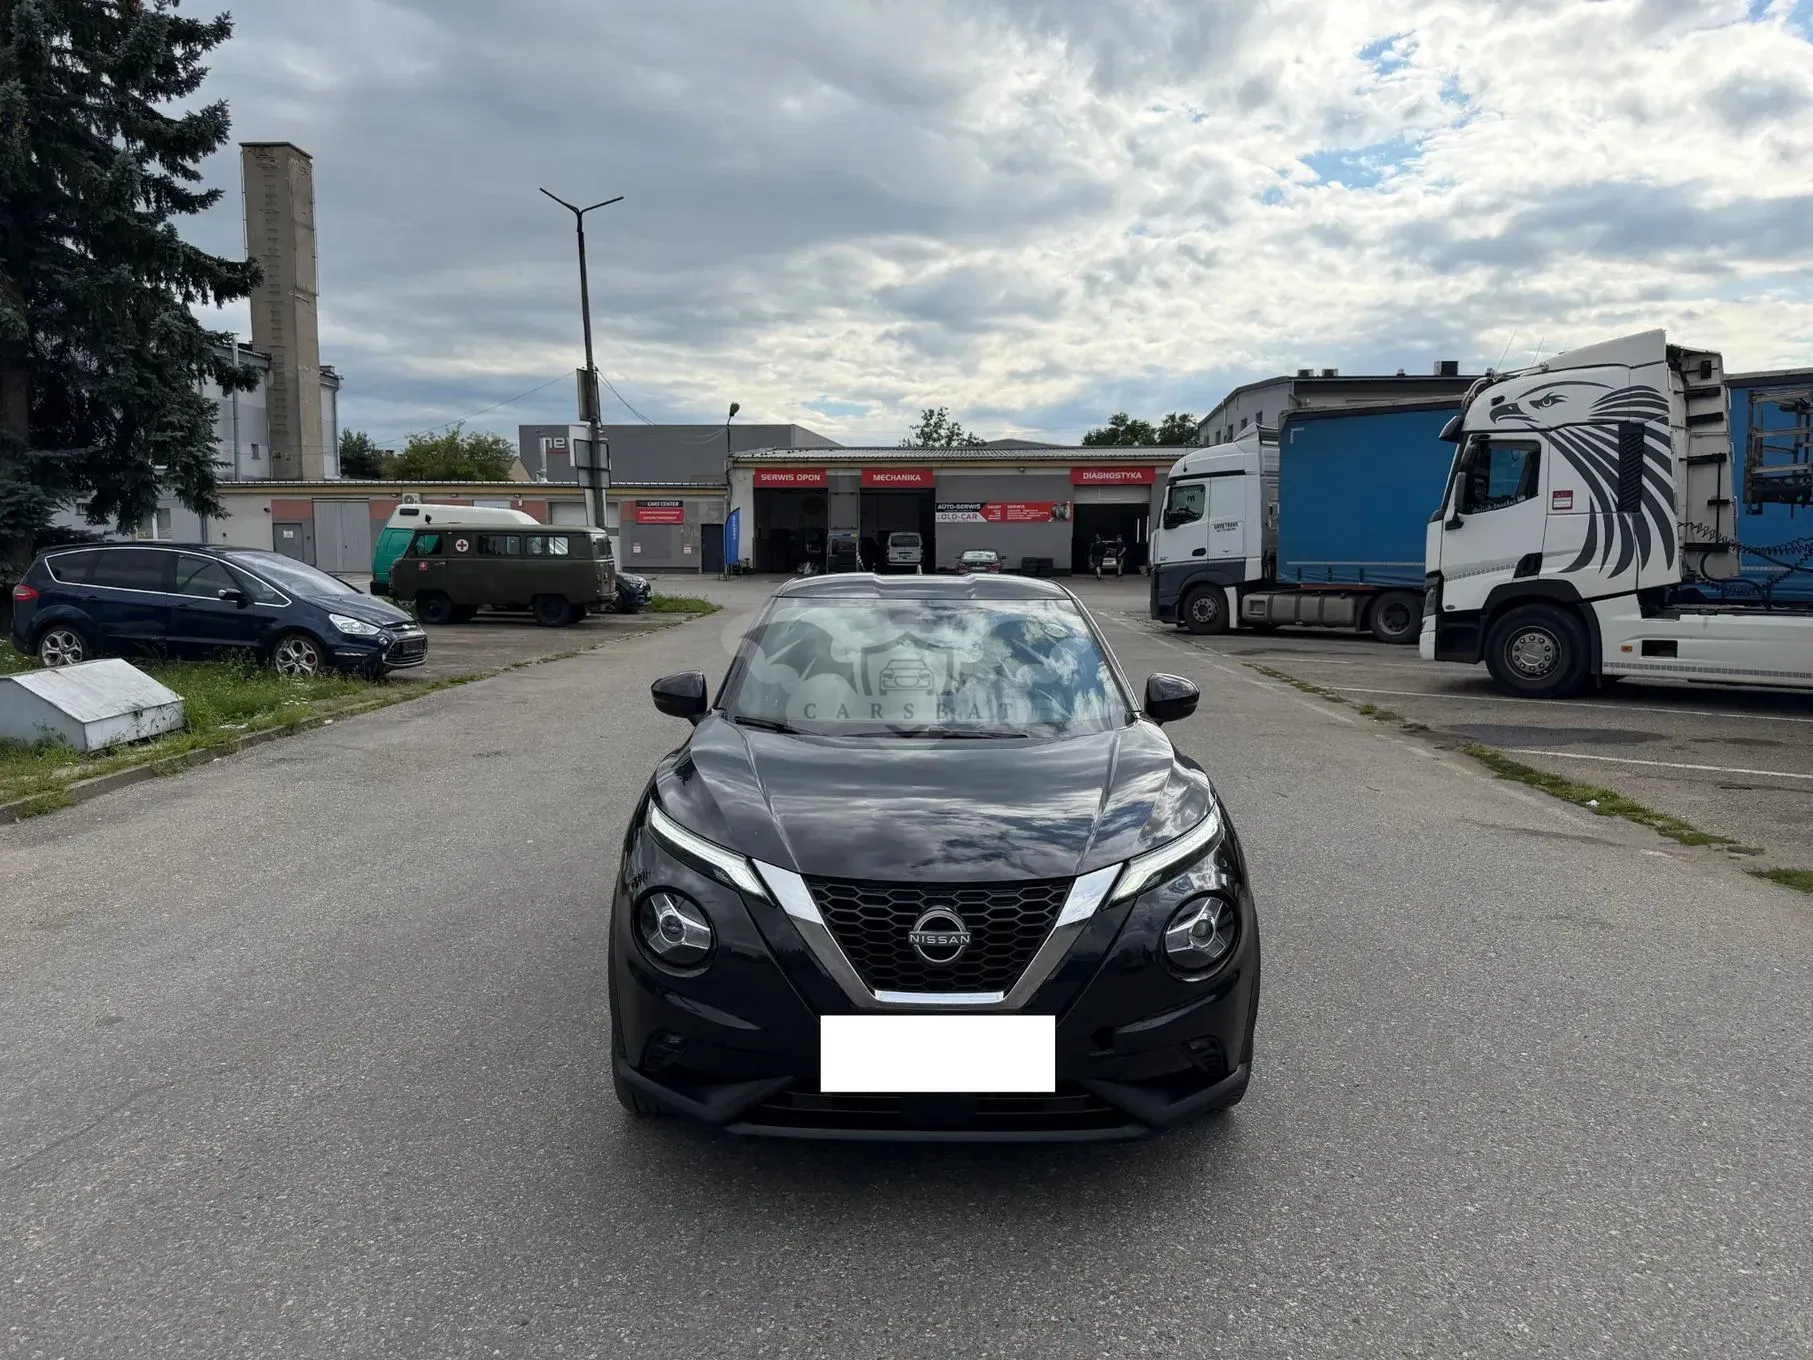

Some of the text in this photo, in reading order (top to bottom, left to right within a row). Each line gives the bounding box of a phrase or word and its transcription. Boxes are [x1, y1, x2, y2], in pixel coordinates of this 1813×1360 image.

[760, 473, 795, 481] SERWIS
[1082, 472, 1142, 480] DIAGNOSTYKA
[909, 934, 970, 944] NISSAN
